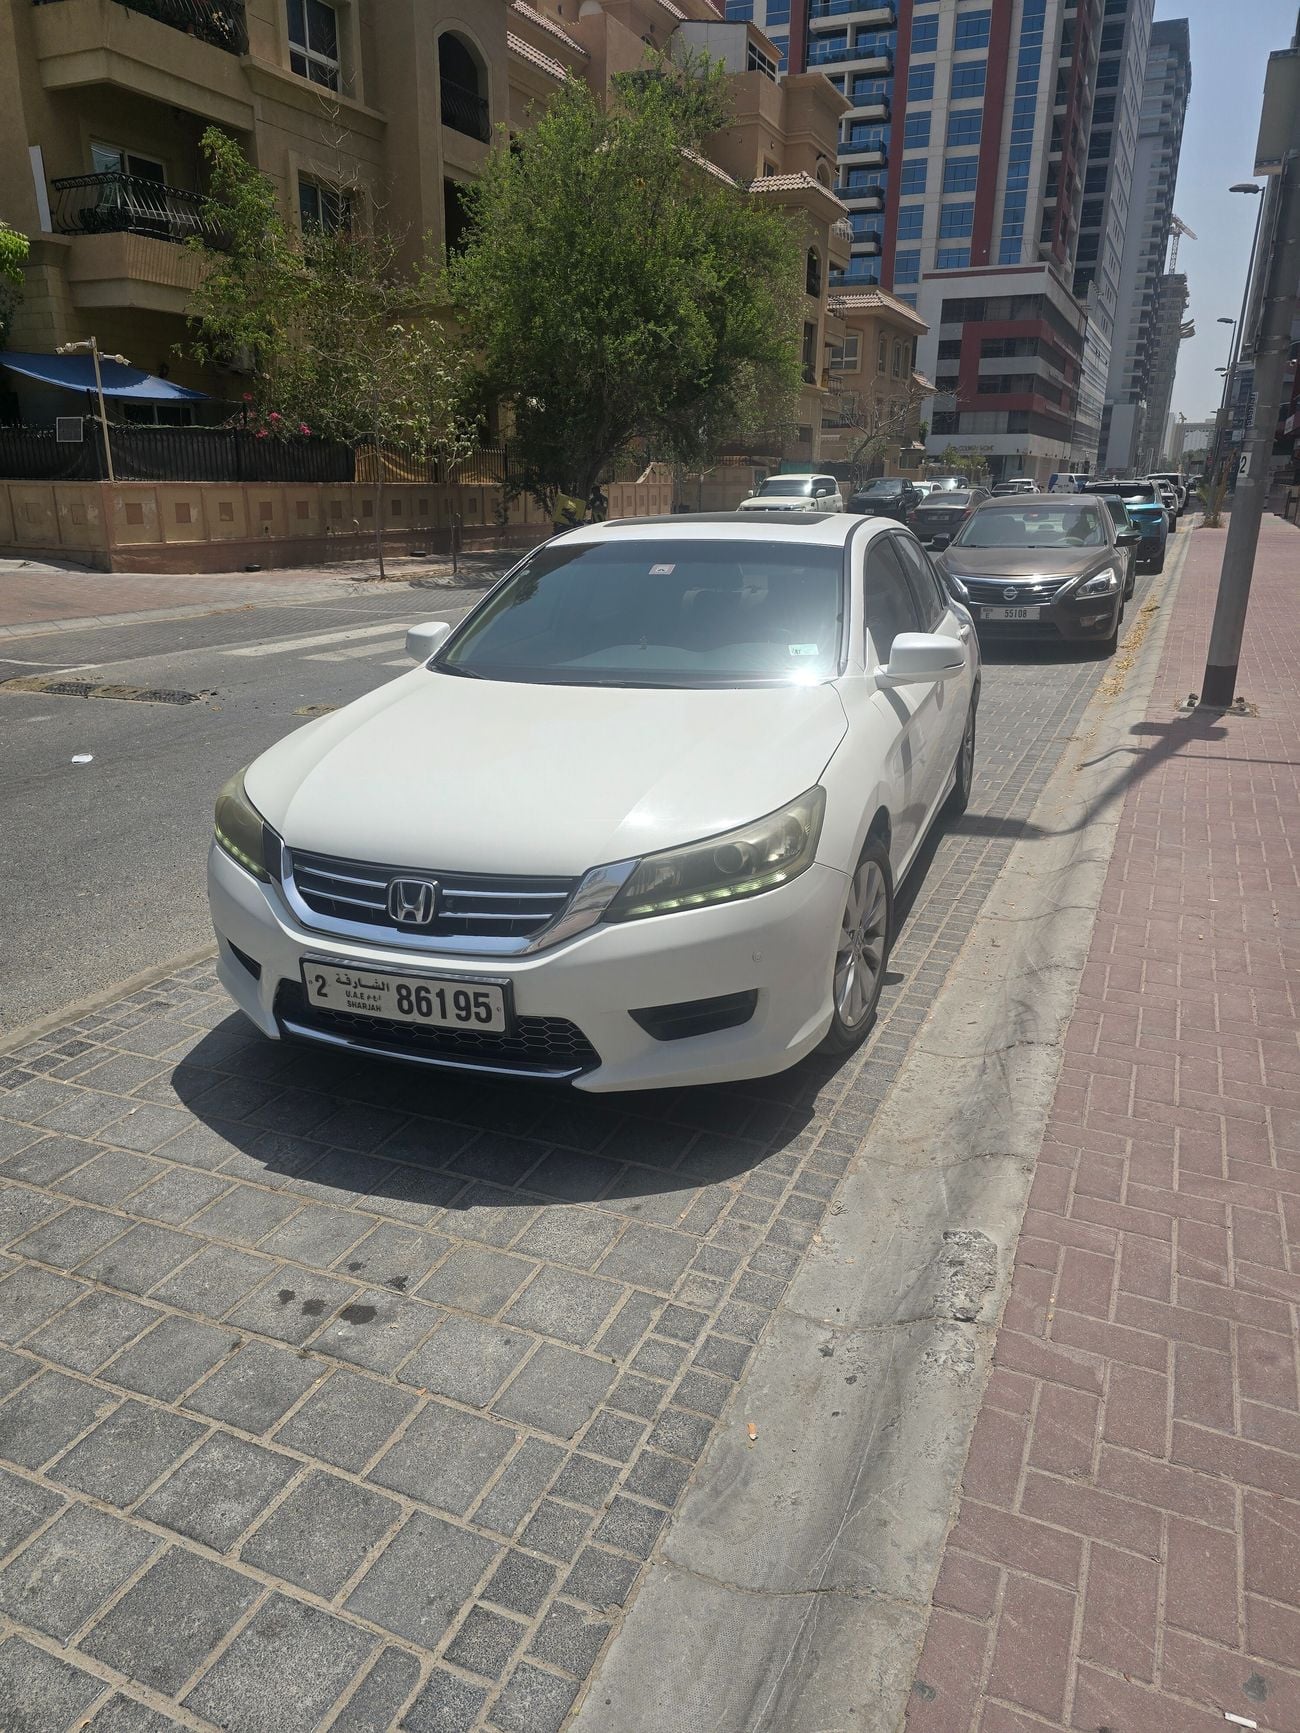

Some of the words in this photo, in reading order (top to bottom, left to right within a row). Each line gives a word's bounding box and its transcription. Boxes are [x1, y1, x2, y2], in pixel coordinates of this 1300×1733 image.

[1239, 456, 1247, 473] 2
[1004, 609, 1027, 618] 55108
[314, 974, 328, 998] 2
[335, 973, 390, 992] الشارقة
[345, 990, 365, 1001] U.A.E
[395, 983, 493, 1024] 86195
[346, 1001, 382, 1013] SHARJAH
